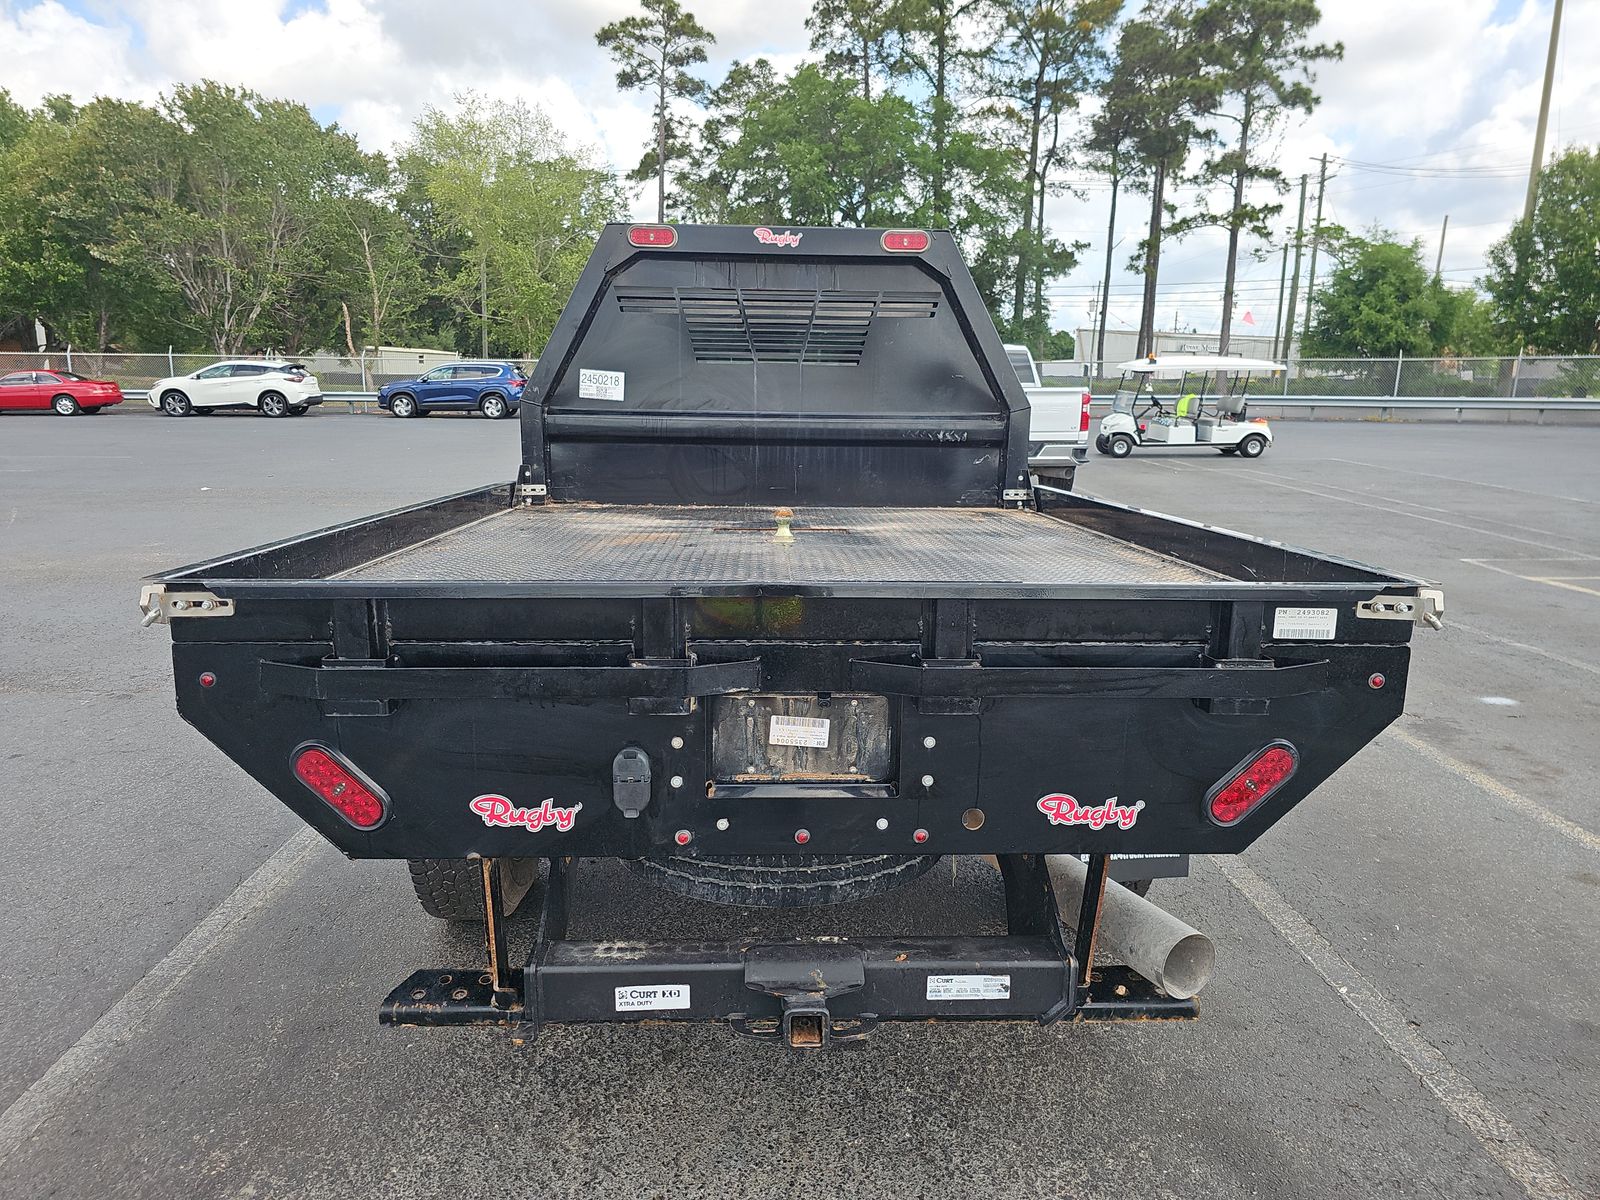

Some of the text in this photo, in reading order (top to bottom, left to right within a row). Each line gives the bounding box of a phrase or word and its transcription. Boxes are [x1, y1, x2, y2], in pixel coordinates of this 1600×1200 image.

[754, 228, 801, 246] Rugby
[581, 373, 620, 387] 2450218
[471, 796, 575, 830] Rugby
[1039, 796, 1136, 828] Rugby
[629, 989, 680, 999] CURT XD
